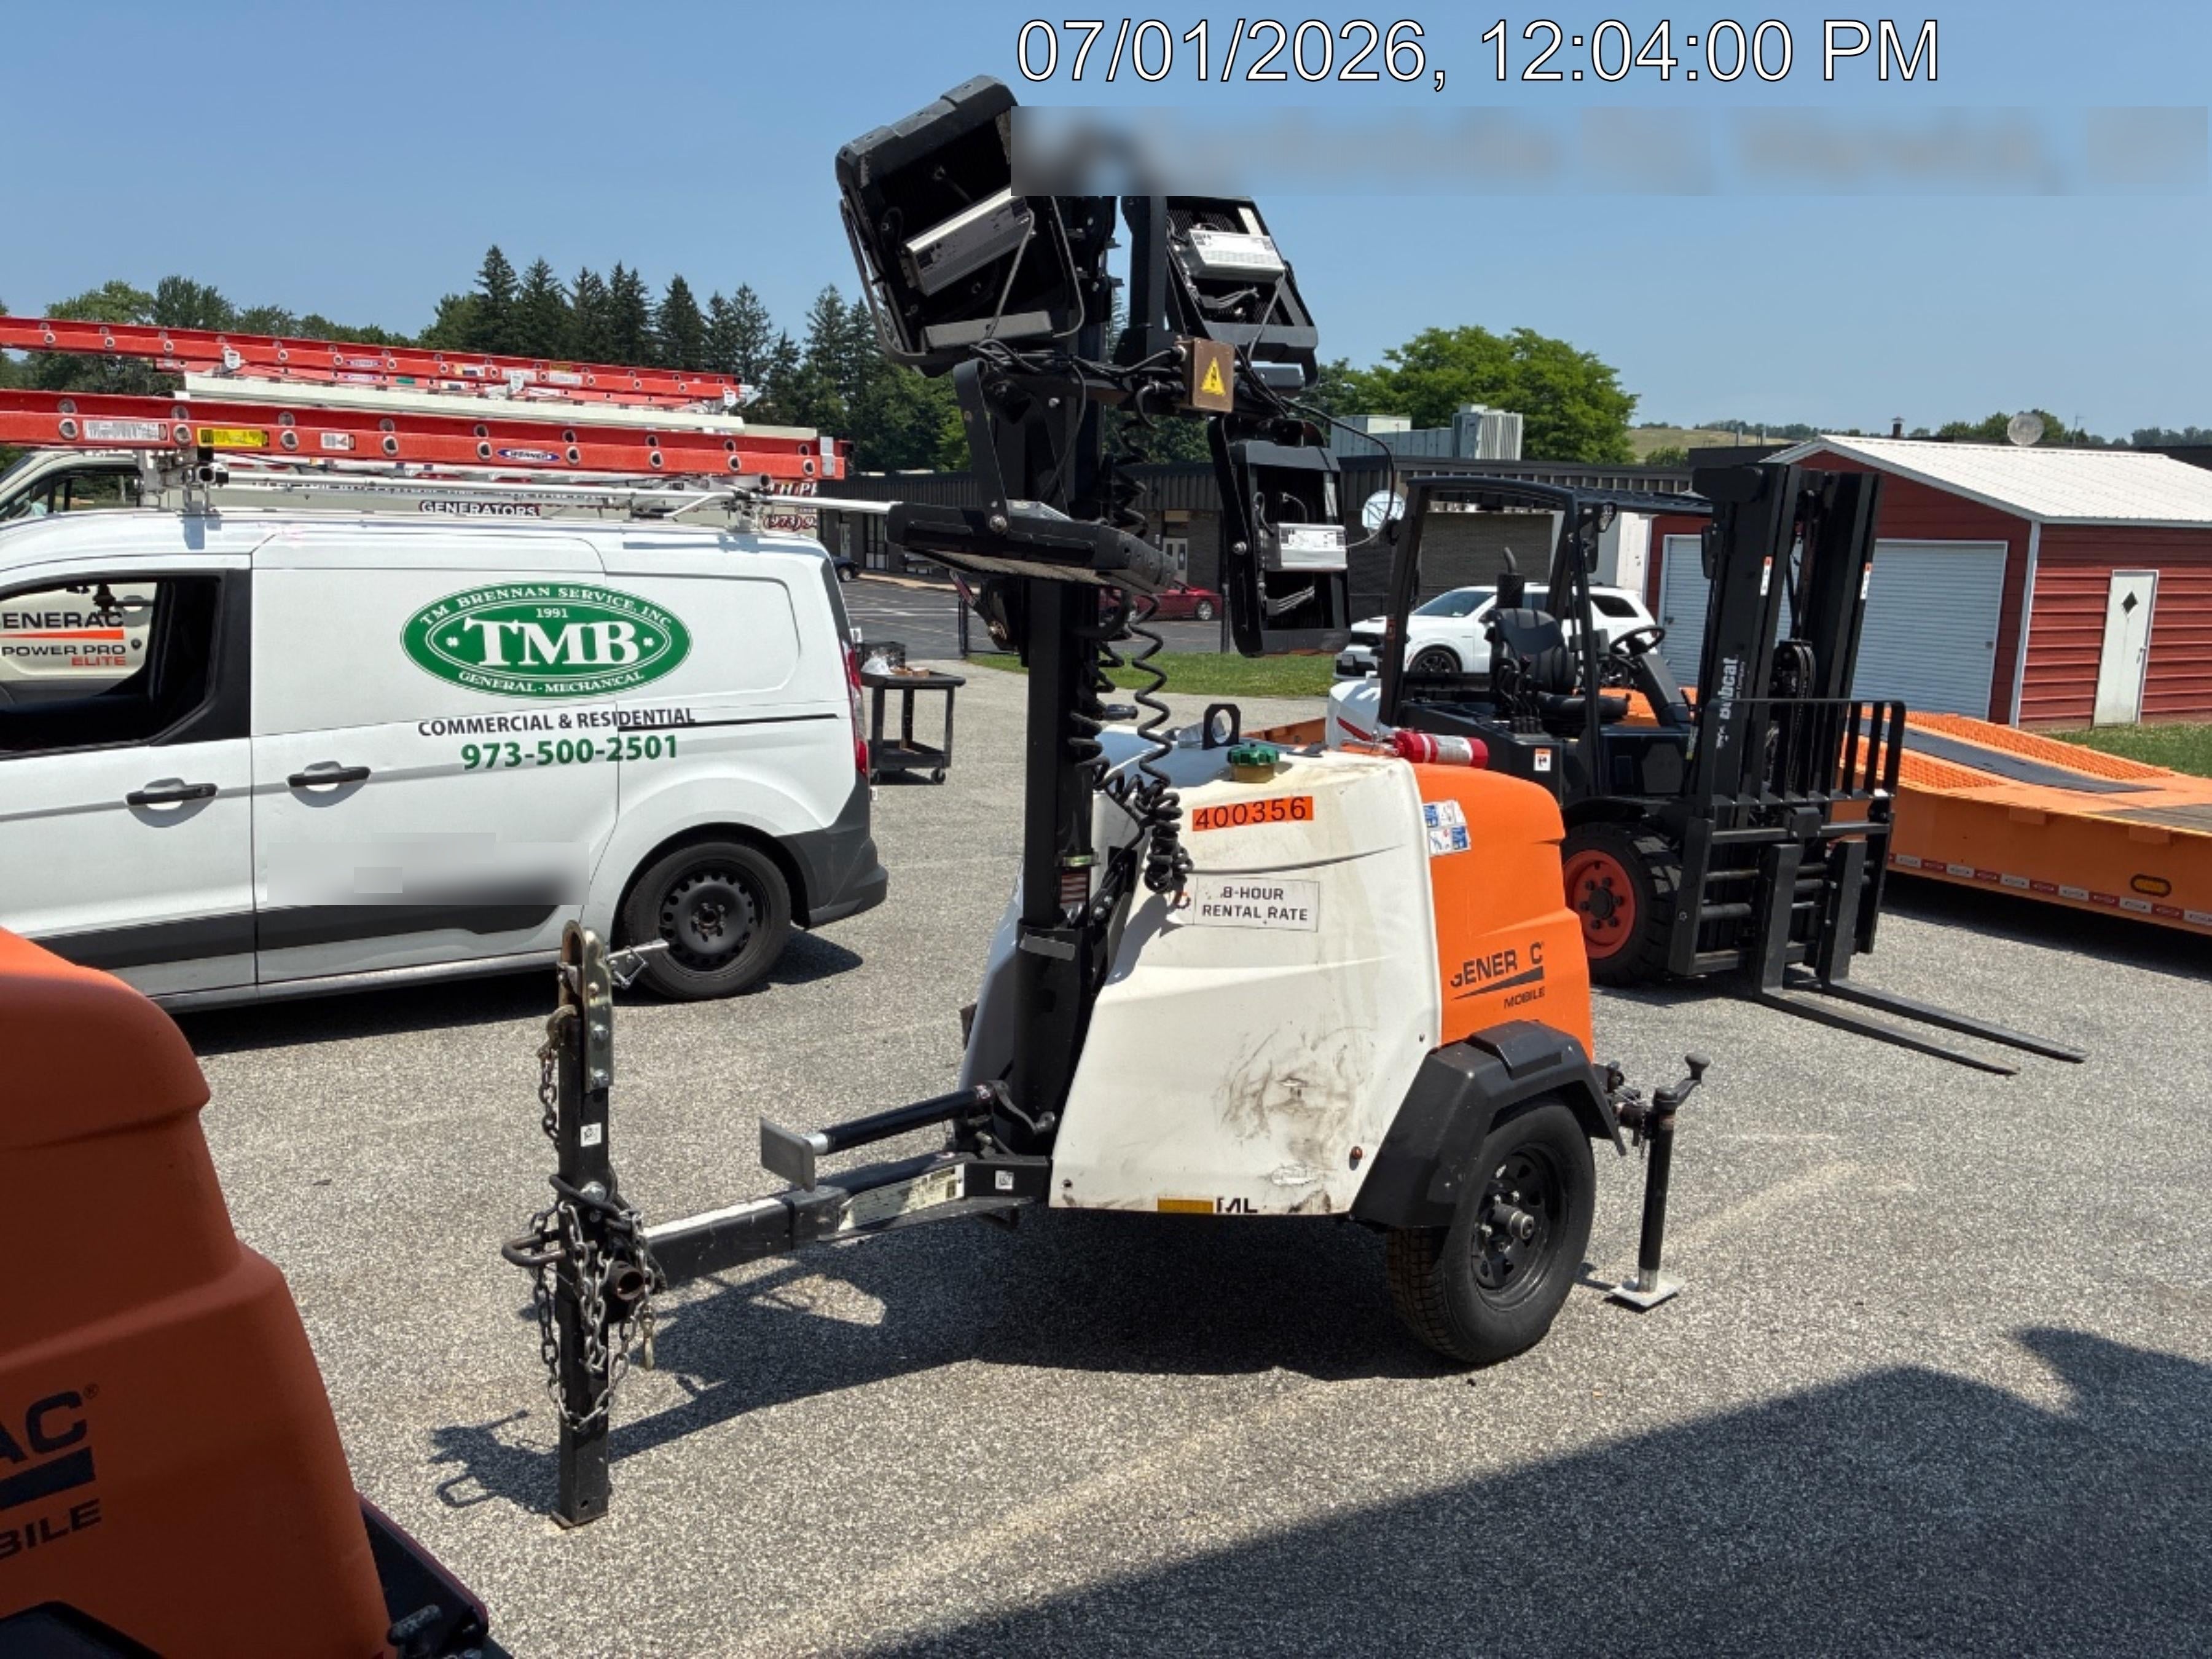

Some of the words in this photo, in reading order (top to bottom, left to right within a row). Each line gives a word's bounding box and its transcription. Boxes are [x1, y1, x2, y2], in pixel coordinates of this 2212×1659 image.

[456, 587, 551, 606] BRENNAN
[558, 587, 637, 613] SERVICE,
[536, 608, 568, 618] 1991
[2, 645, 77, 656] POWER
[83, 645, 126, 655] PRO
[463, 616, 640, 665] TMB
[71, 656, 126, 666] ELITE
[418, 714, 554, 737] COMMERCIAL
[558, 713, 572, 729] &
[576, 708, 696, 728] RESIDENTIAL
[461, 735, 677, 770] 973-500-2501
[1196, 797, 1306, 828] 400356
[1223, 887, 1284, 900] 8-HOUR
[1202, 904, 1261, 919] RENTAL
[1268, 906, 1308, 921] RATE
[1504, 986, 1545, 1009] MOBILE
